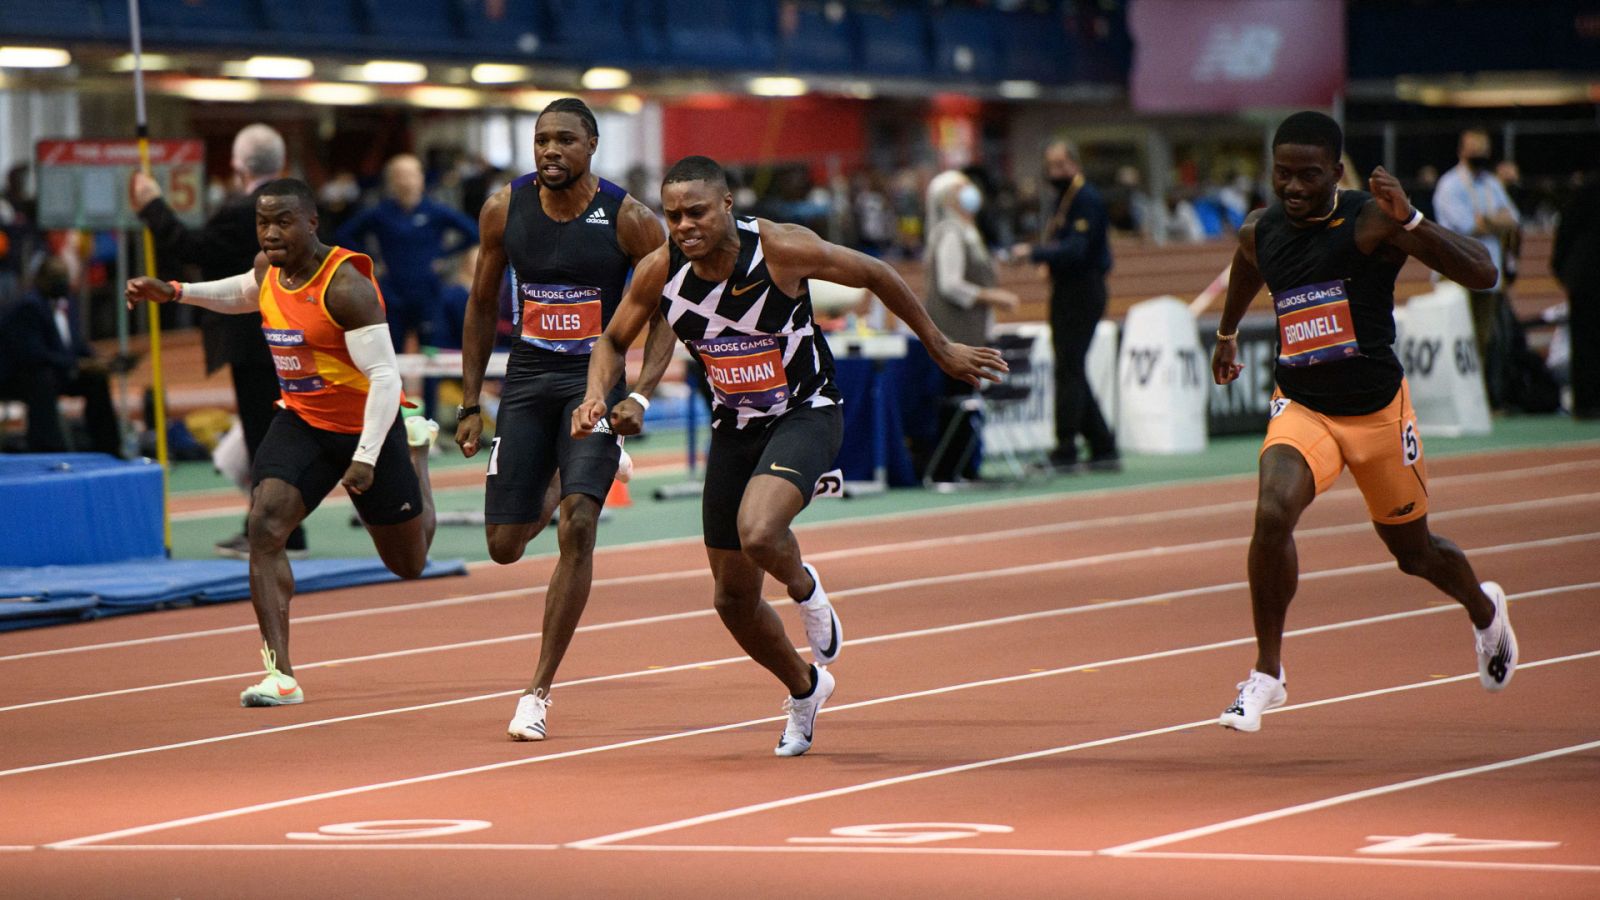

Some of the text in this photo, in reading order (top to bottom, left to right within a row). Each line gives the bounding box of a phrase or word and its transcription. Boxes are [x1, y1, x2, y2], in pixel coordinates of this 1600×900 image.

[523, 289, 598, 299] MILLROSE GAMES
[1277, 286, 1343, 309] MILLROSE GAMES
[541, 313, 581, 331] LYLES
[1284, 314, 1344, 345] BROMELL
[696, 338, 775, 353] MILLROSE GAMES
[710, 361, 775, 385] COLEMAN
[1405, 424, 1418, 461] 5
[786, 822, 1015, 843] 5
[1355, 832, 1562, 854] 4
